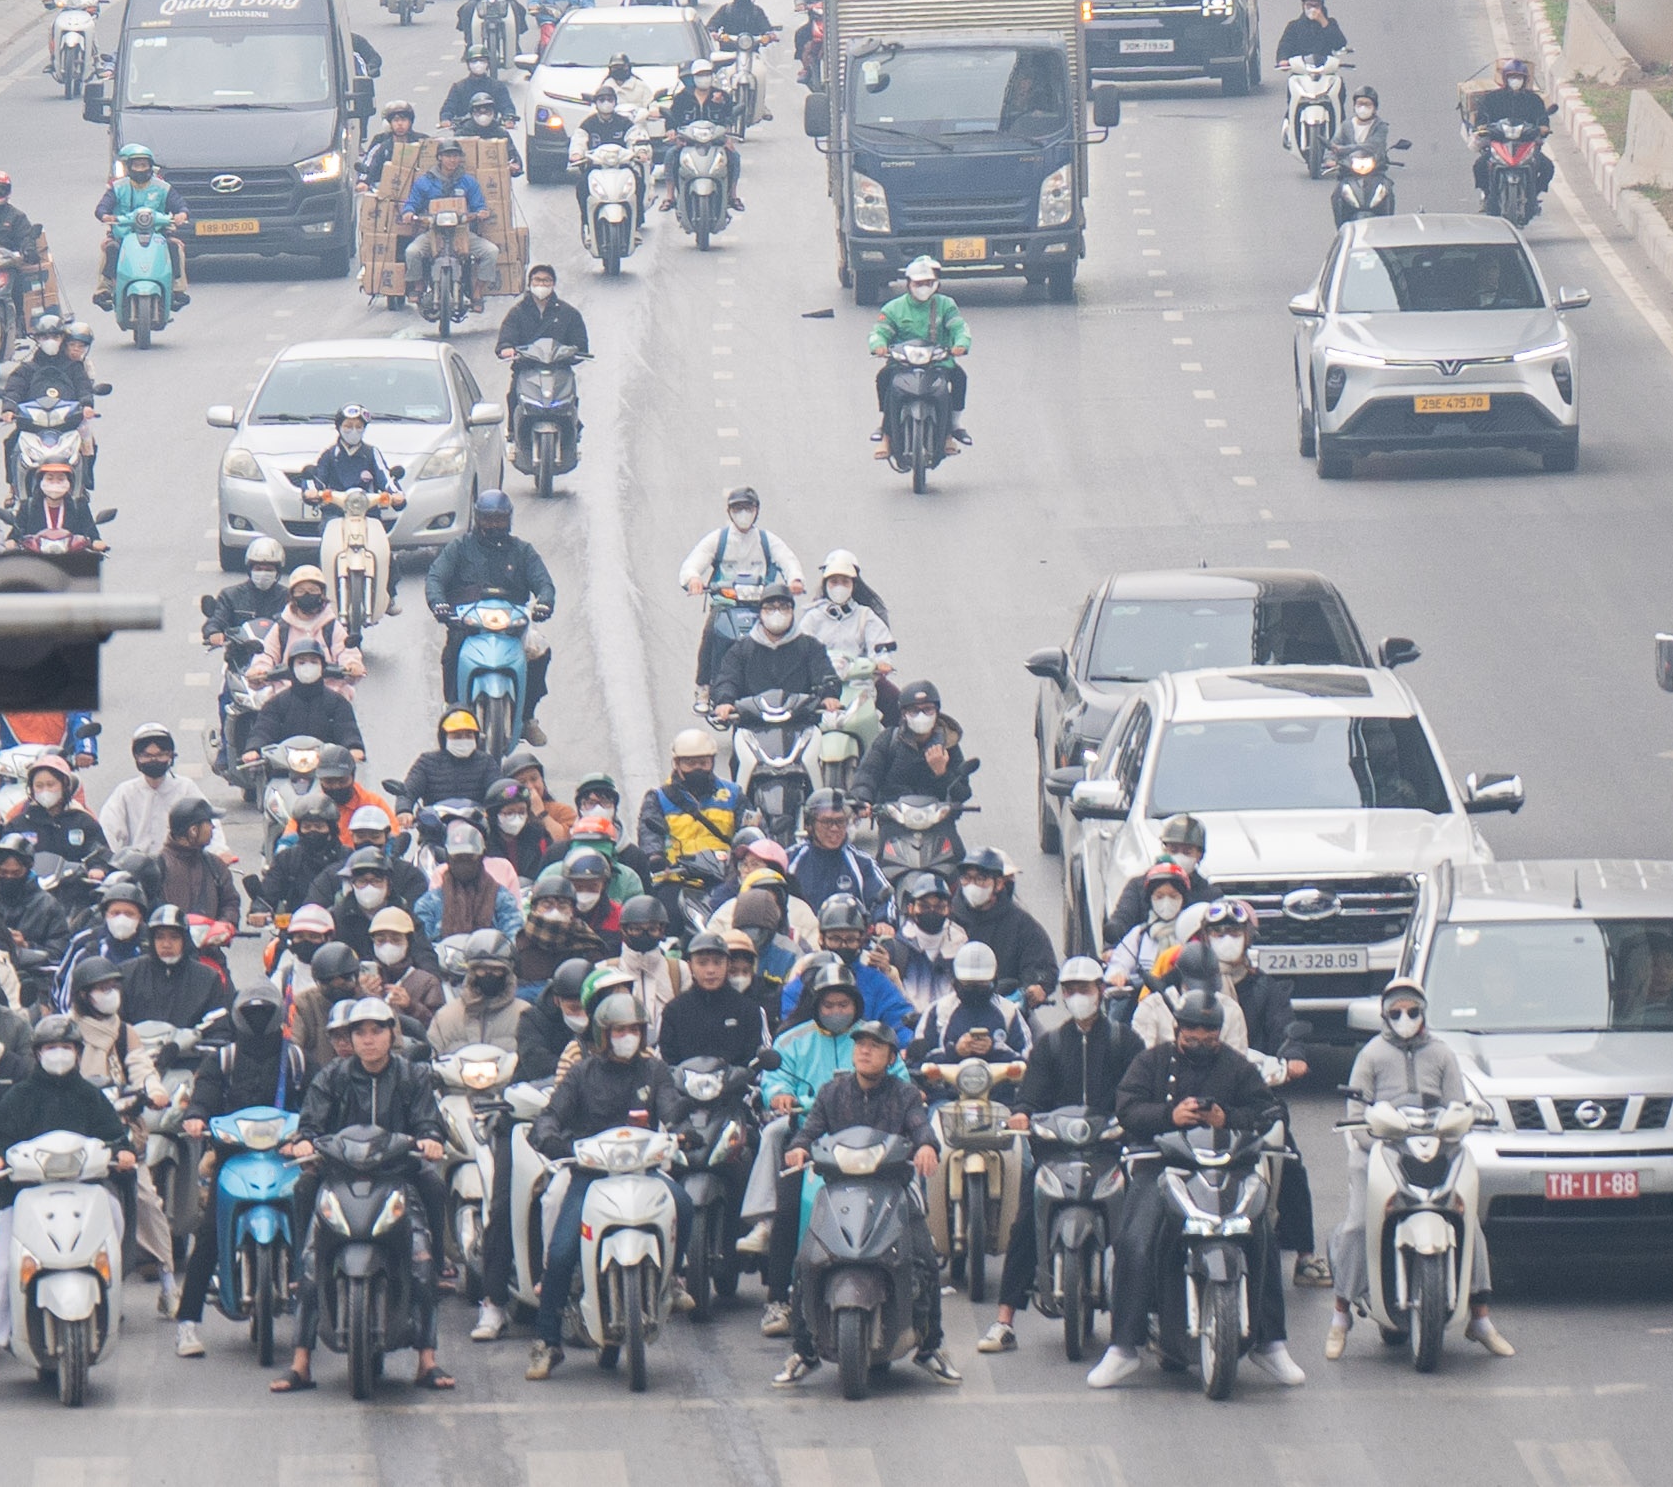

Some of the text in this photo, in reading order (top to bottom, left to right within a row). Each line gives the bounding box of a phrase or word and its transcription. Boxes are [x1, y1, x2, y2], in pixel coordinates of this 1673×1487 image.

[209, 10, 269, 19] LIMOUSINE
[1421, 396, 1484, 410] 29E-475.70
[1268, 952, 1358, 970] 22A-328.09
[1548, 1172, 1637, 1196] TH-11-88
